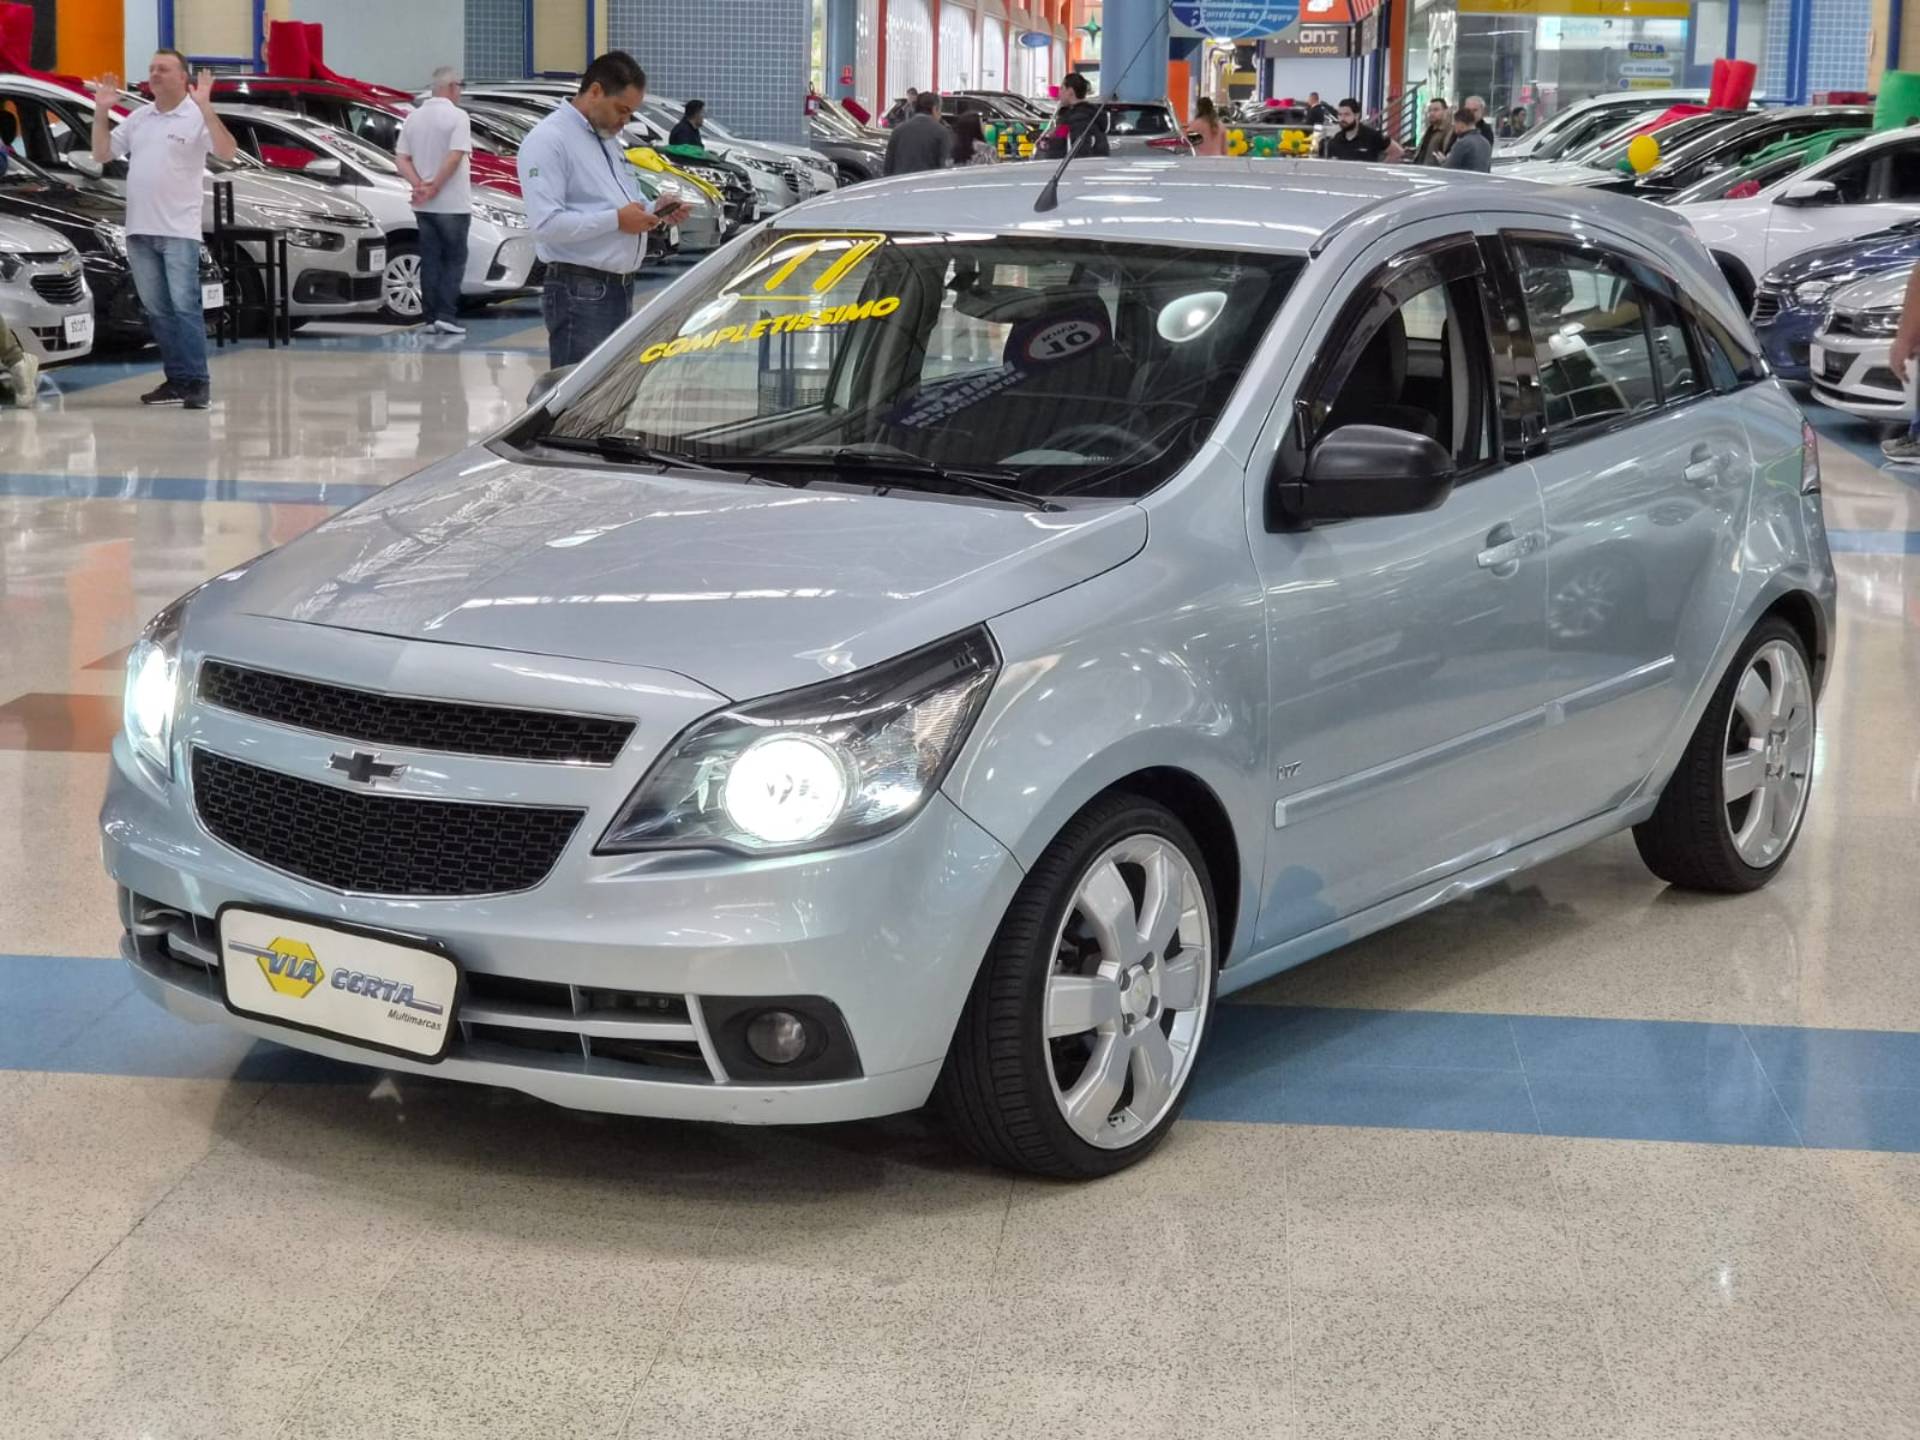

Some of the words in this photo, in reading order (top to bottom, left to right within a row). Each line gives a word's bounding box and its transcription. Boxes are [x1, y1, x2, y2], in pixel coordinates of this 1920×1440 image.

[1299, 46, 1338, 54] MOTORS
[639, 297, 900, 363] COMPLETISSIMO
[267, 950, 317, 984] VIA
[387, 1008, 443, 1031] Multimarcas
